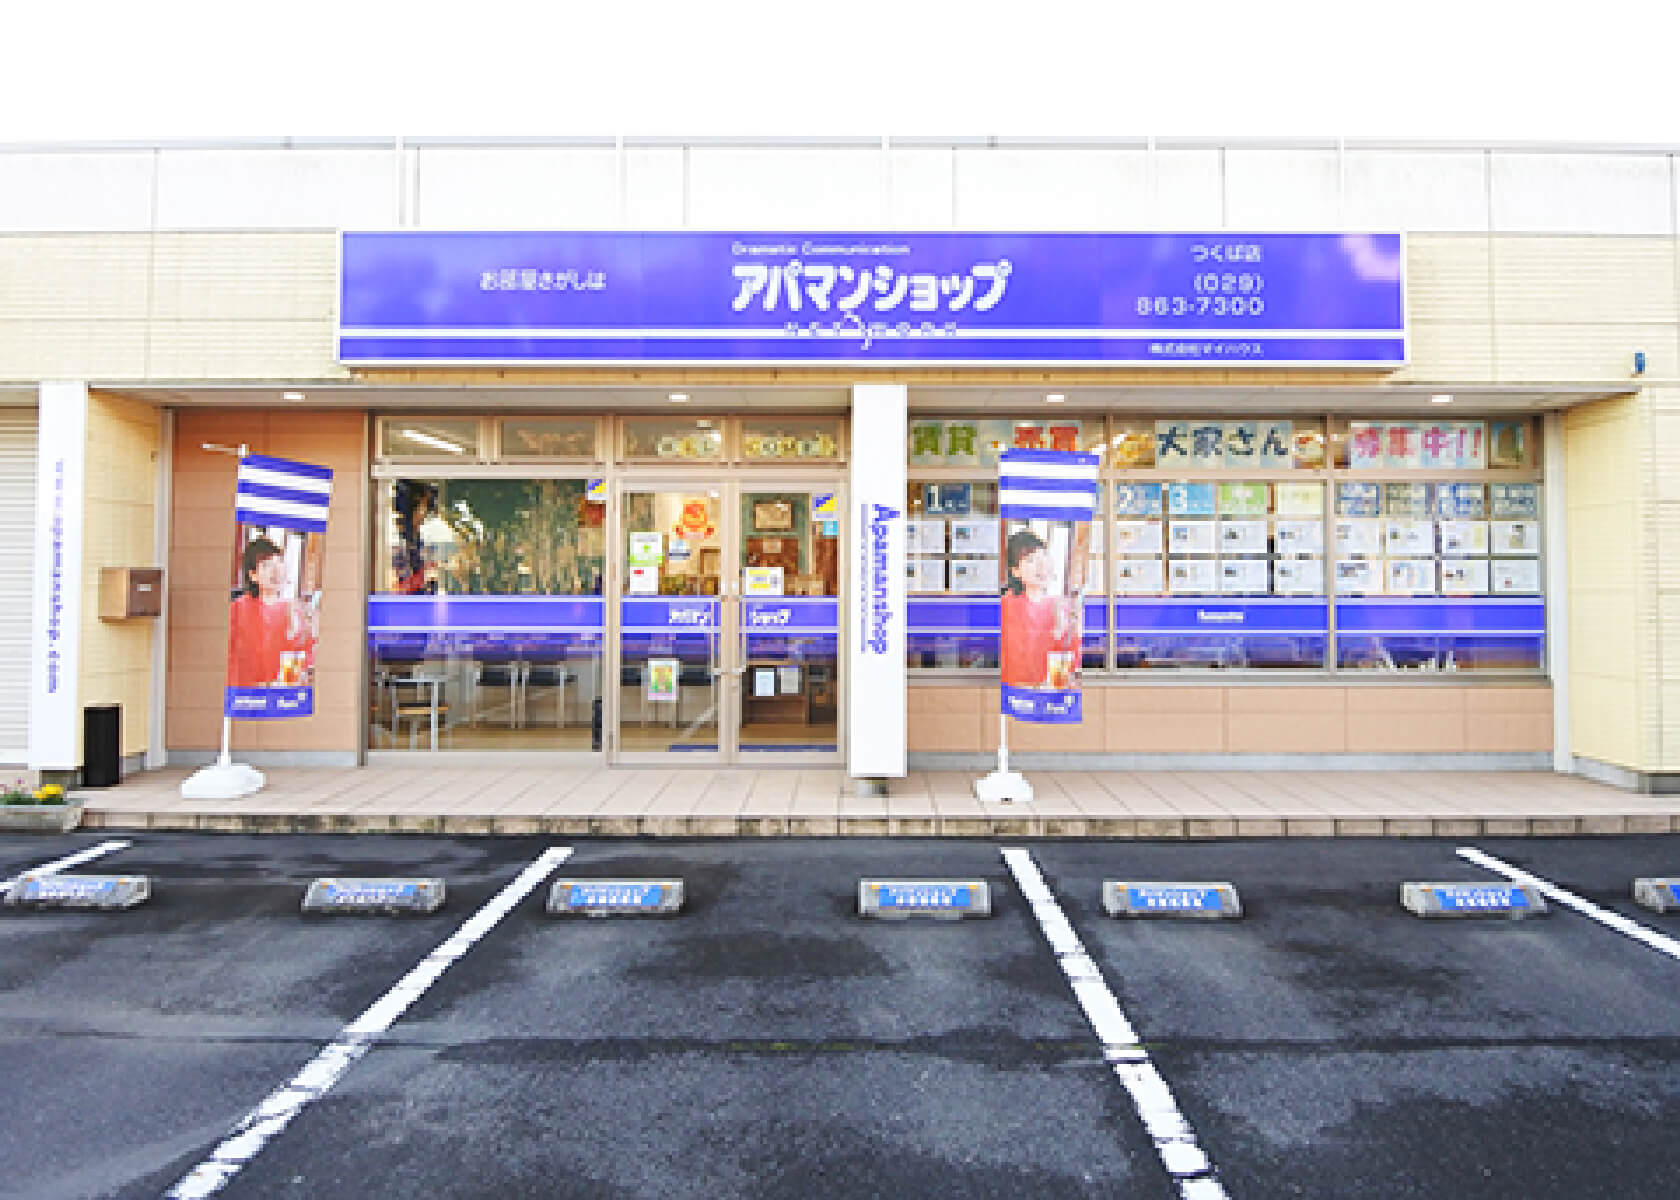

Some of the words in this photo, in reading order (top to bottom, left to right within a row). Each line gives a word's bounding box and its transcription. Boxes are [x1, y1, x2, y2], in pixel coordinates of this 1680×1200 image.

[1191, 244, 1262, 263] つくば店
[480, 268, 607, 291] お部屋さがしは
[731, 259, 1013, 312] アパマンショップ
[1157, 426, 1290, 457] 大家さん
